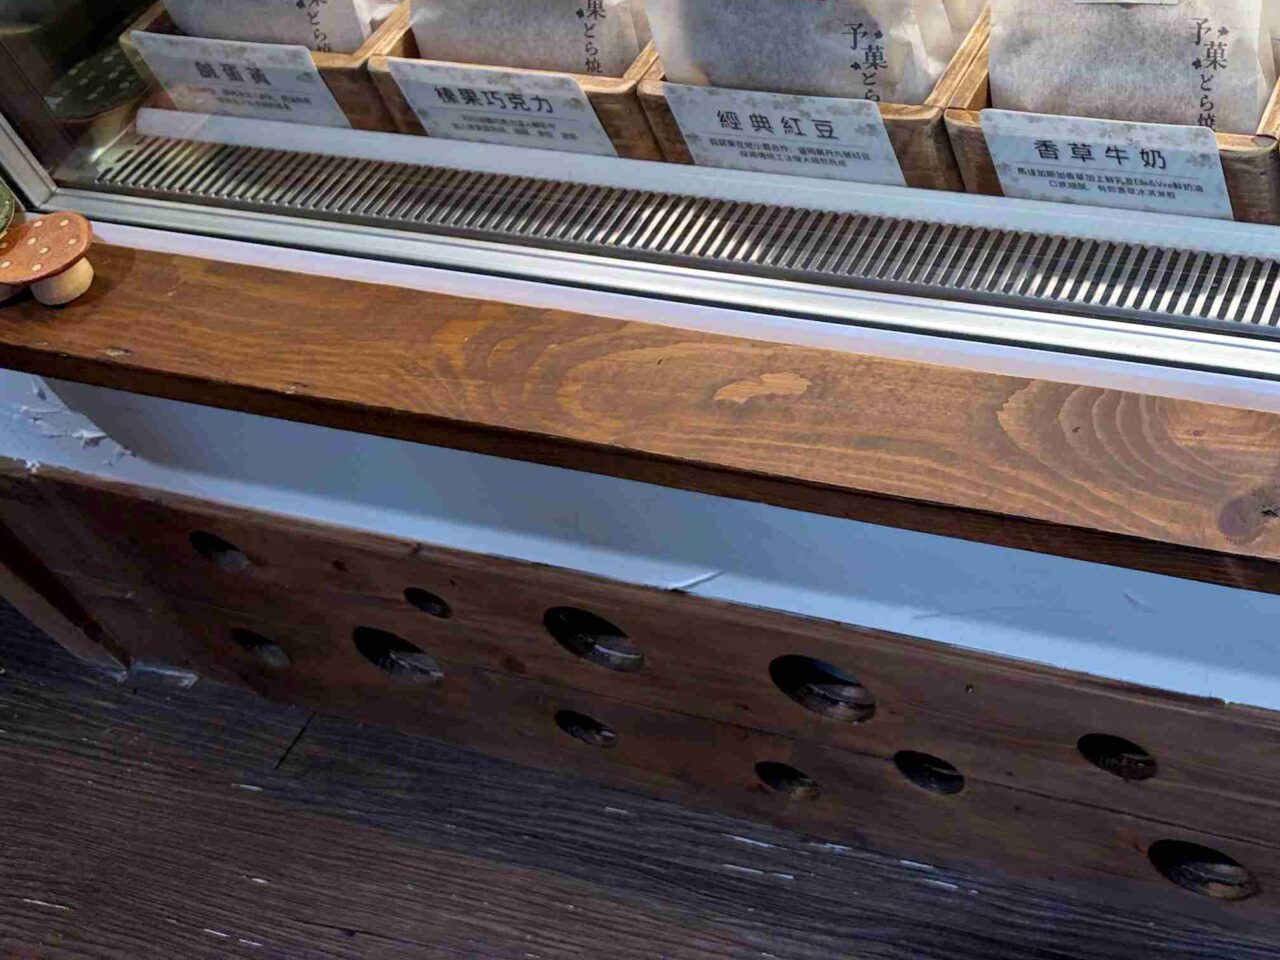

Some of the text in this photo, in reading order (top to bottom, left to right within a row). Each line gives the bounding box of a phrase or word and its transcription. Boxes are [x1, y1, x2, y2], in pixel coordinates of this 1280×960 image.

[433, 86, 555, 114] 榛果巧克力
[717, 110, 840, 140] 經典紅豆
[1034, 139, 1168, 170] 香草牛奶
